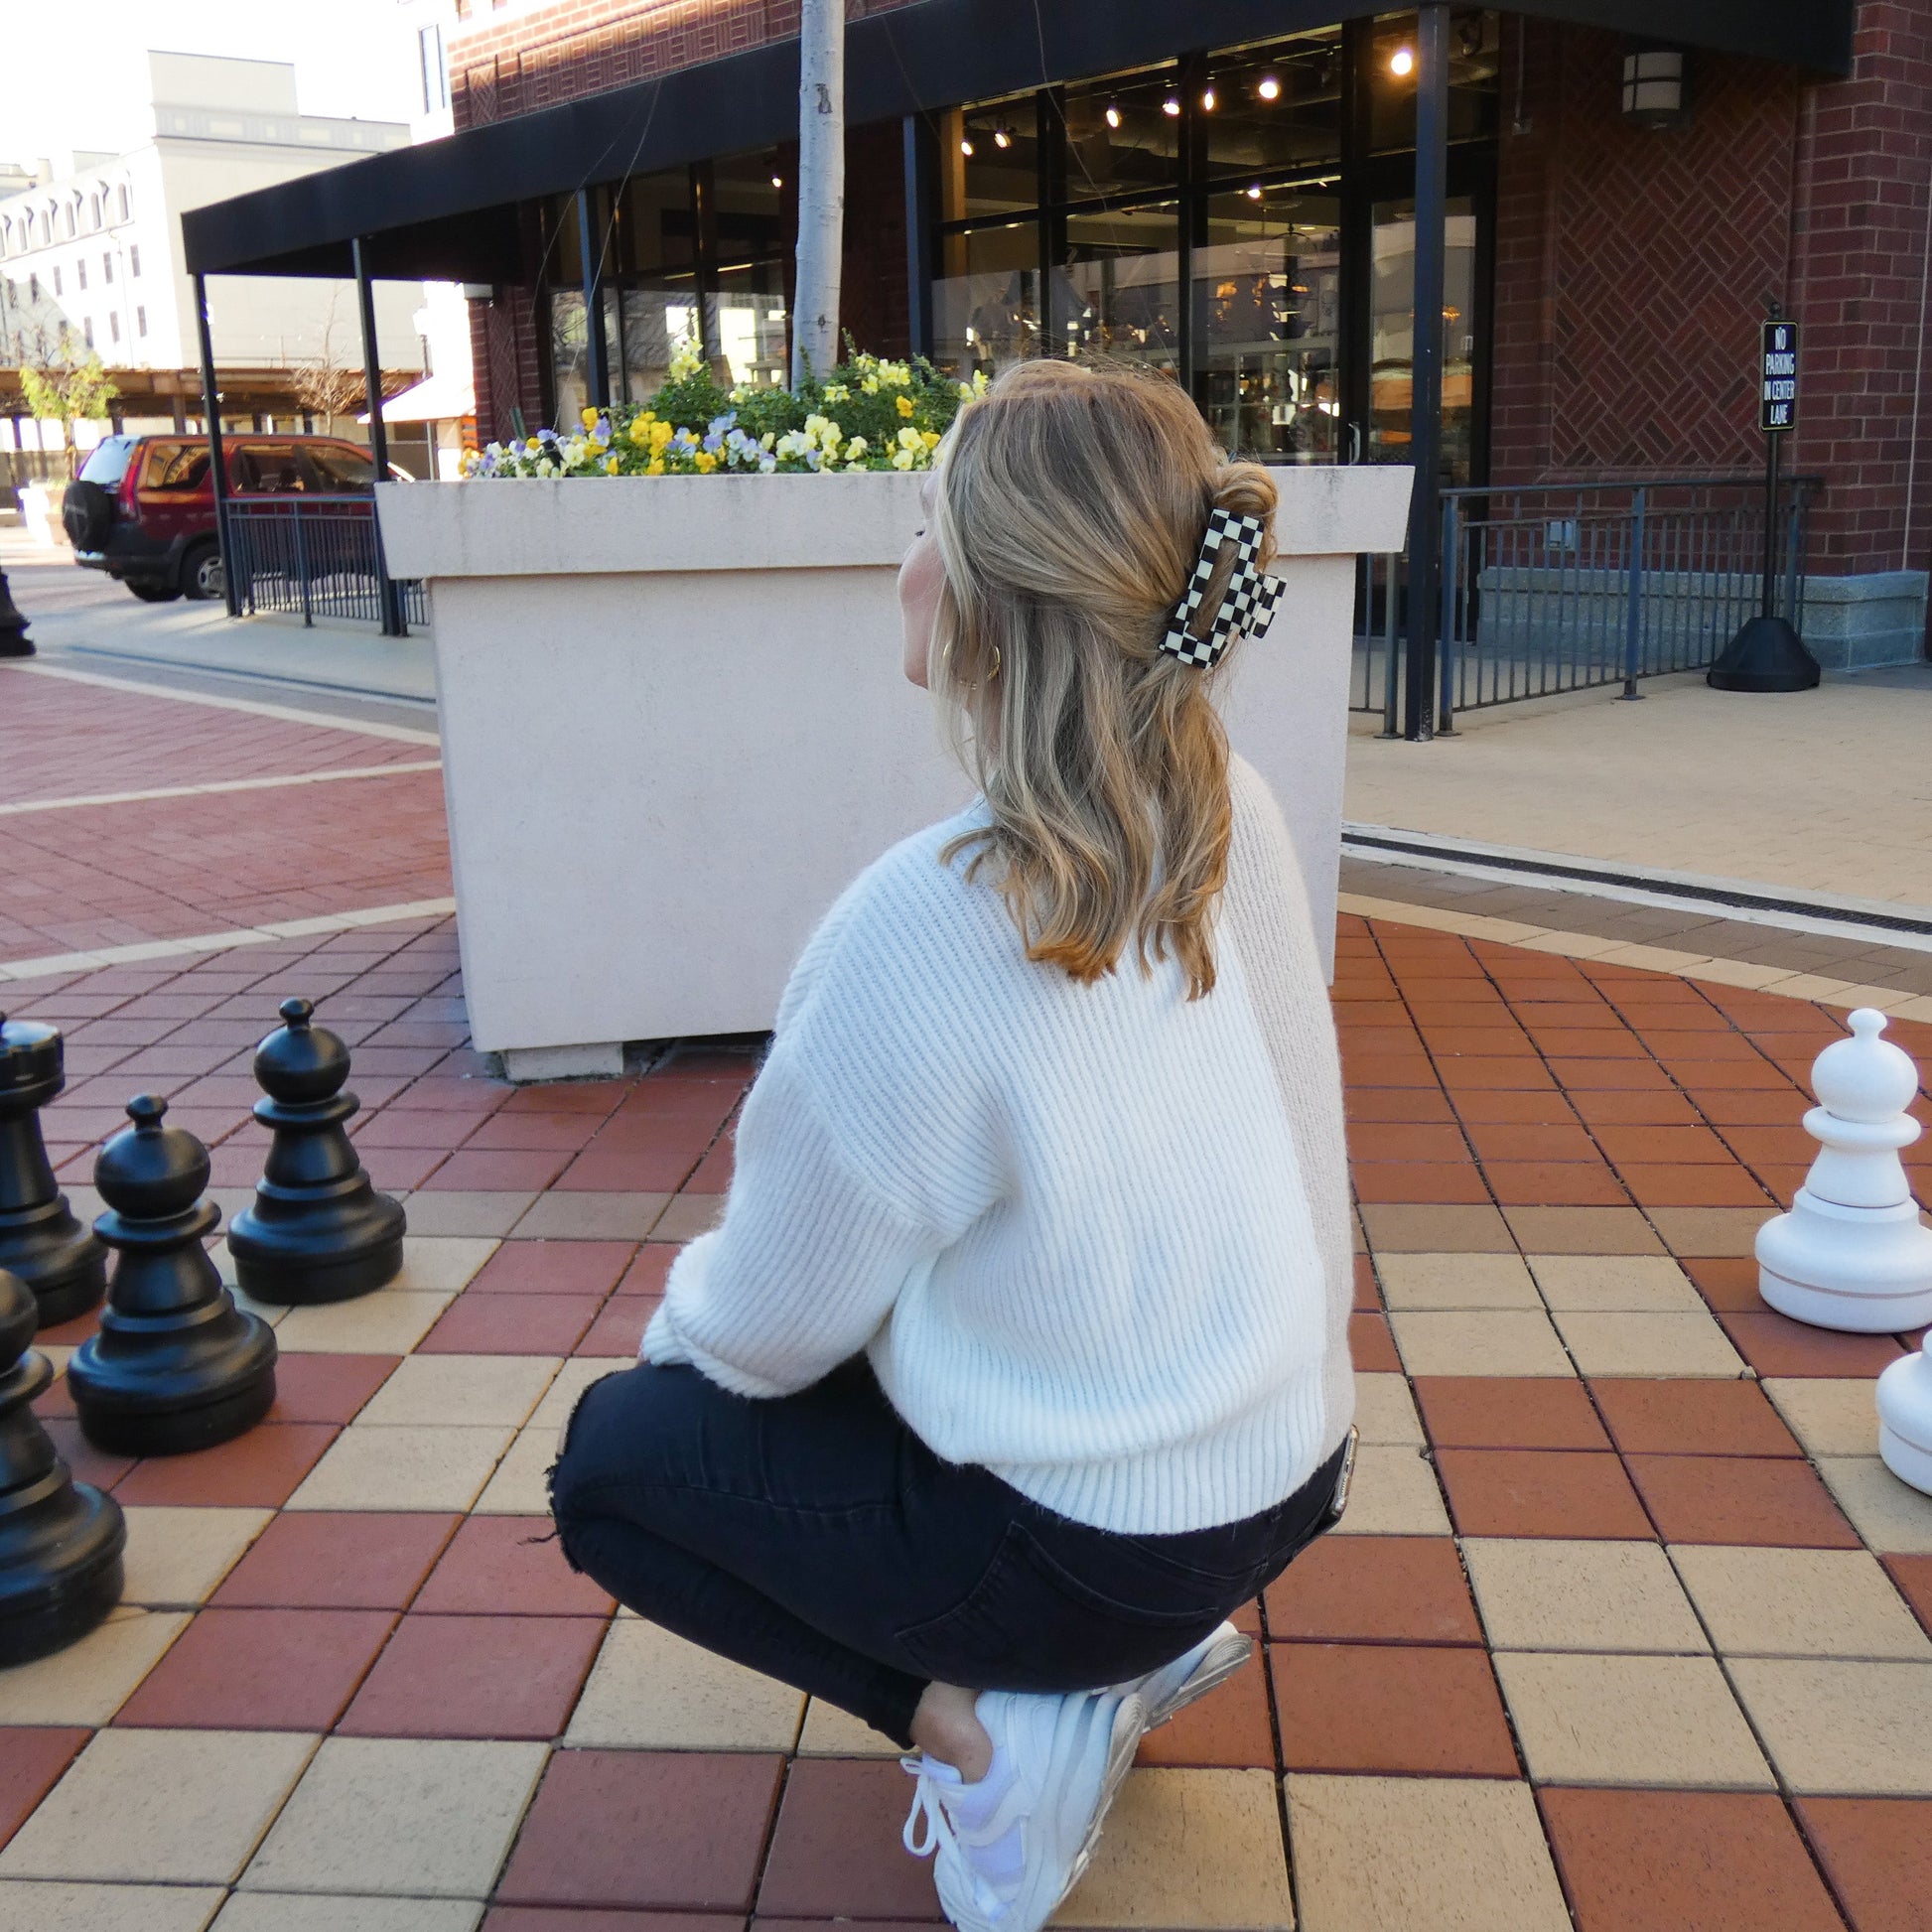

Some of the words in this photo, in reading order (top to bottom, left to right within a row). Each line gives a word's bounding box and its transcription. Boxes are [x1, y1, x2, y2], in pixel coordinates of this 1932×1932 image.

[1775, 329, 1786, 349] NO
[1766, 353, 1794, 374] PARKING
[1764, 381, 1771, 400] IN
[1772, 380, 1795, 400] CENTER
[1770, 404, 1788, 424] LANE
